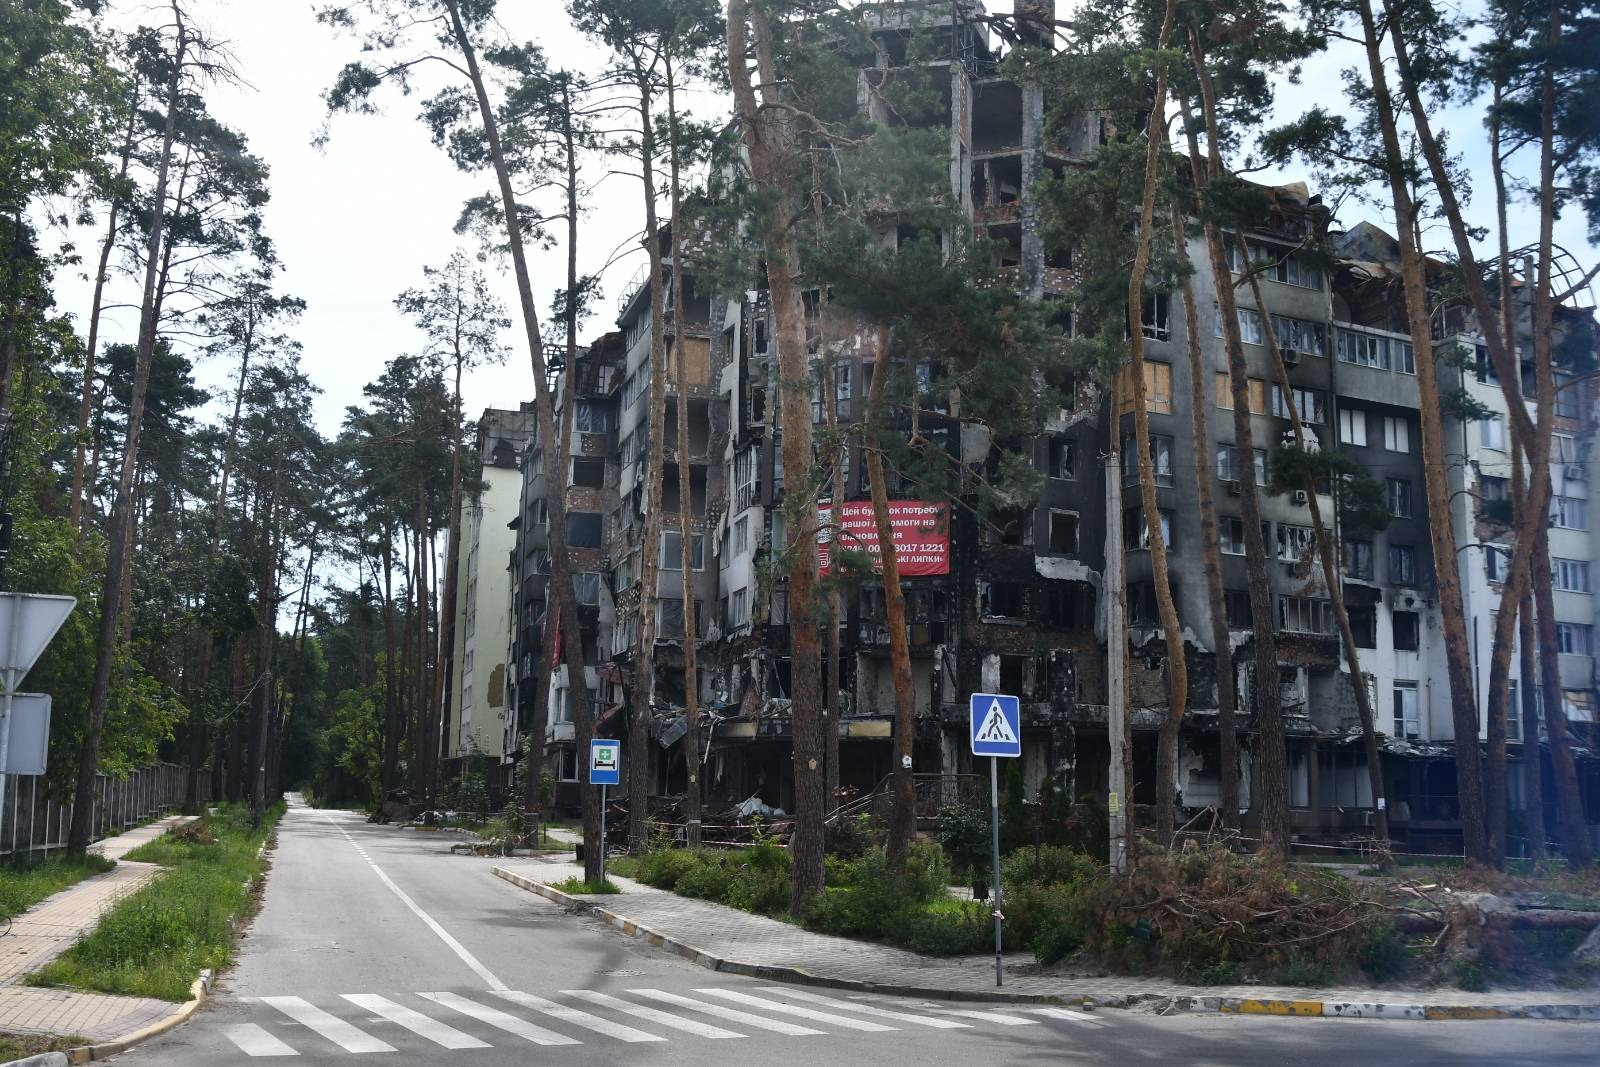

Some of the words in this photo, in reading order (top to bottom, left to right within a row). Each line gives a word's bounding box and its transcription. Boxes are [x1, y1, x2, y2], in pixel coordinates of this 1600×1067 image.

[842, 506, 859, 517] Цей
[861, 506, 901, 517] буок
[842, 518, 870, 529] вашої
[922, 519, 935, 527] на
[919, 543, 945, 552] 1221
